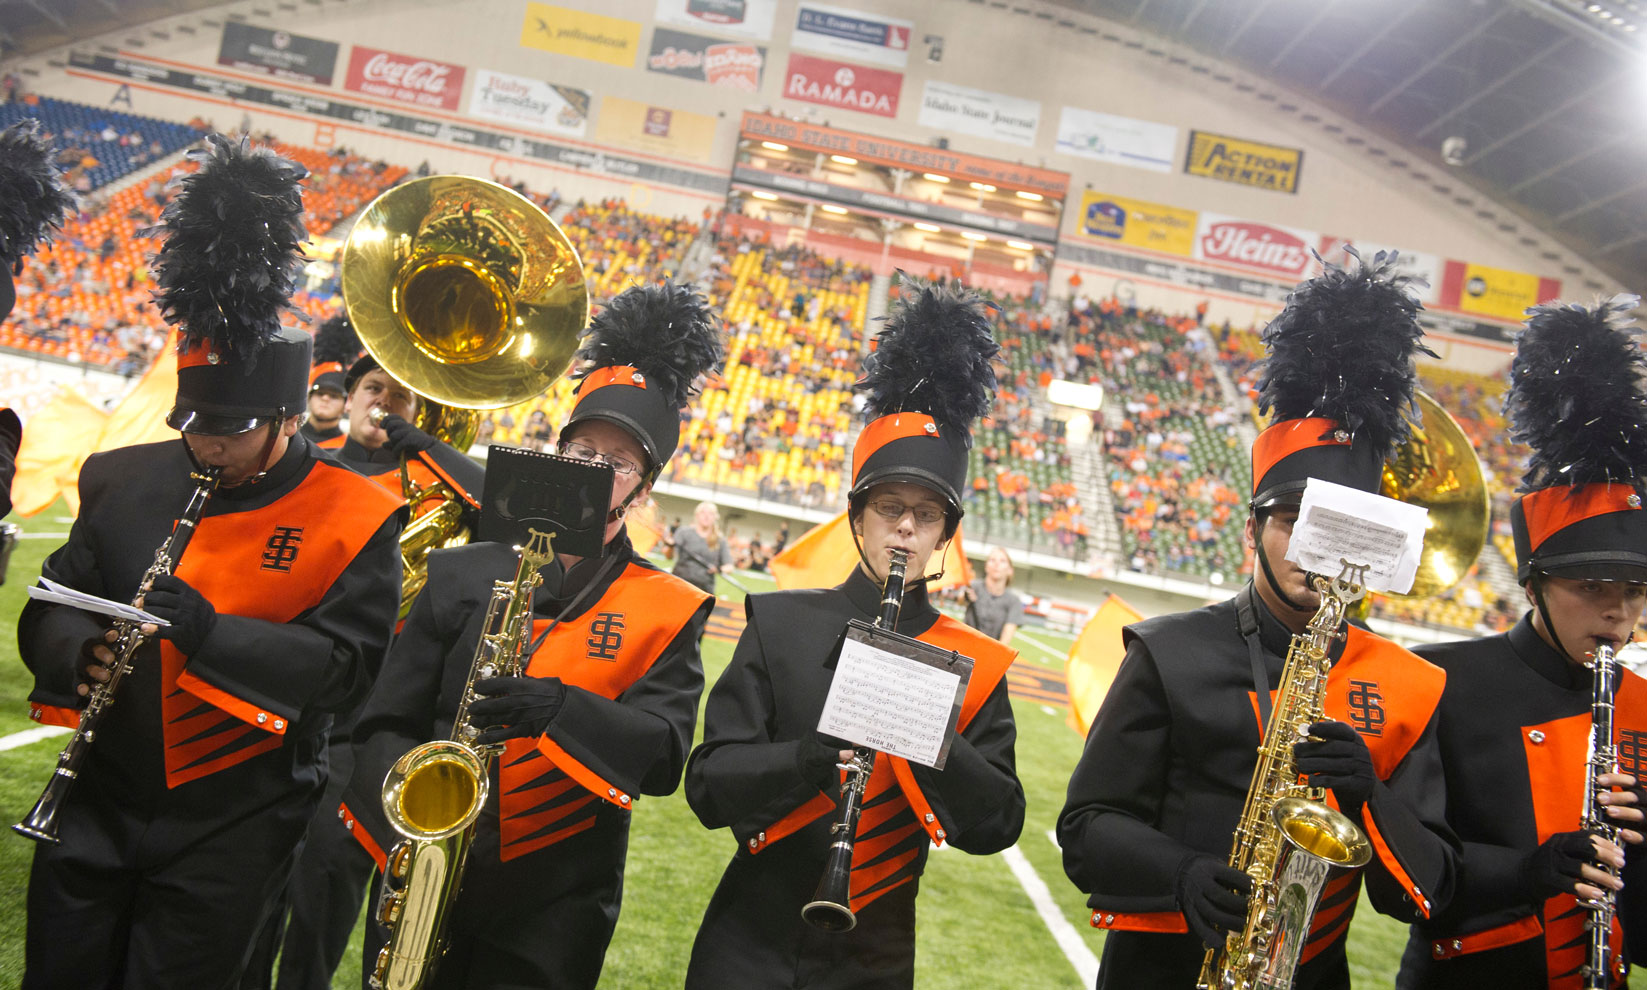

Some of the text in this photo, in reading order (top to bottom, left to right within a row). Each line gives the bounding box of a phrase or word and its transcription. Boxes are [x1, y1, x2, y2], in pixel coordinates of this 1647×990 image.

[481, 87, 550, 115] Tuesday
[488, 76, 530, 97] Ruby
[789, 73, 891, 112] RAMADA
[925, 96, 1036, 130] Idaho State Journal
[746, 118, 797, 141] IDAHO
[803, 129, 852, 151] STATE
[856, 139, 960, 172] UNIVERSITY
[1204, 143, 1292, 172] ACTION
[1214, 164, 1287, 188] RENTAL
[1206, 226, 1305, 270] Heinz
